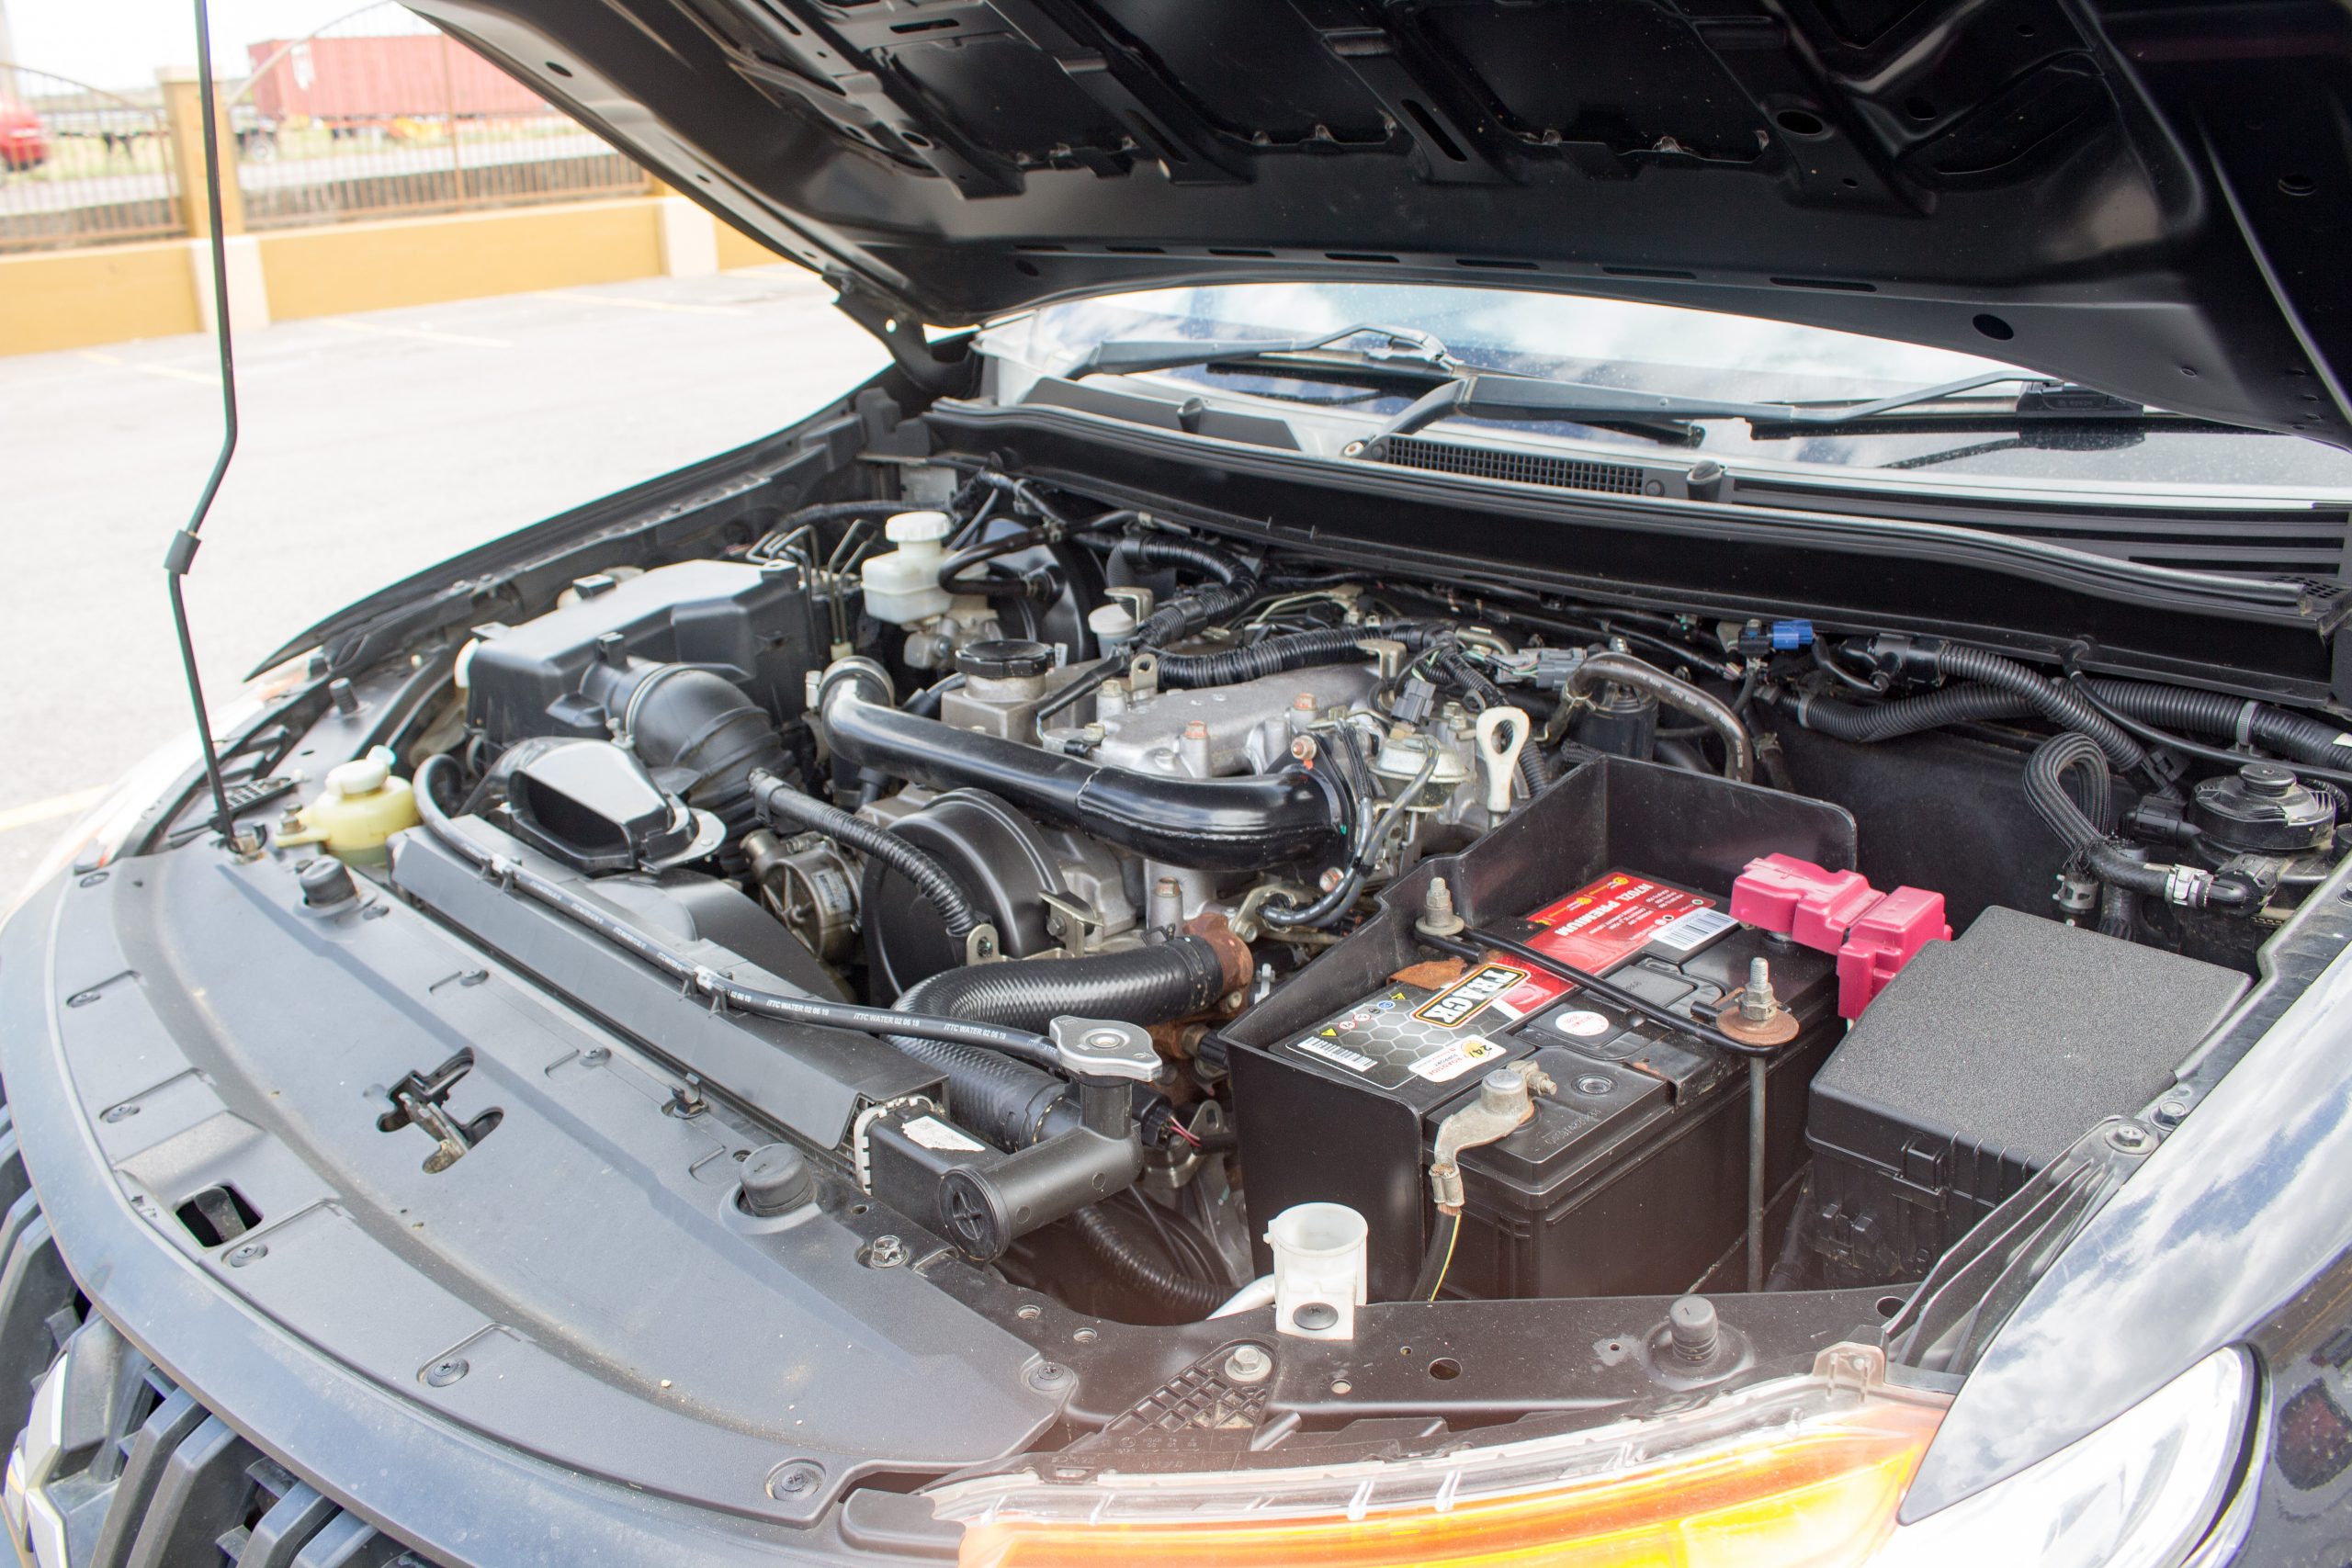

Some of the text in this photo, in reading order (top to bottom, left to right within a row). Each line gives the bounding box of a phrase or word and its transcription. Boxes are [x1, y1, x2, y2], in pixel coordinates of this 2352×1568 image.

[1555, 900, 1621, 937] PREMIUM
[1423, 970, 1518, 1023] TRACK
[781, 1001, 804, 1011] WATER
[854, 1012, 920, 1027] ITTC WATER 02 06 19
[959, 1024, 981, 1036] WATER
[982, 1029, 990, 1037] 02
[990, 1031, 999, 1039] 06
[1000, 1032, 1006, 1040] 19
